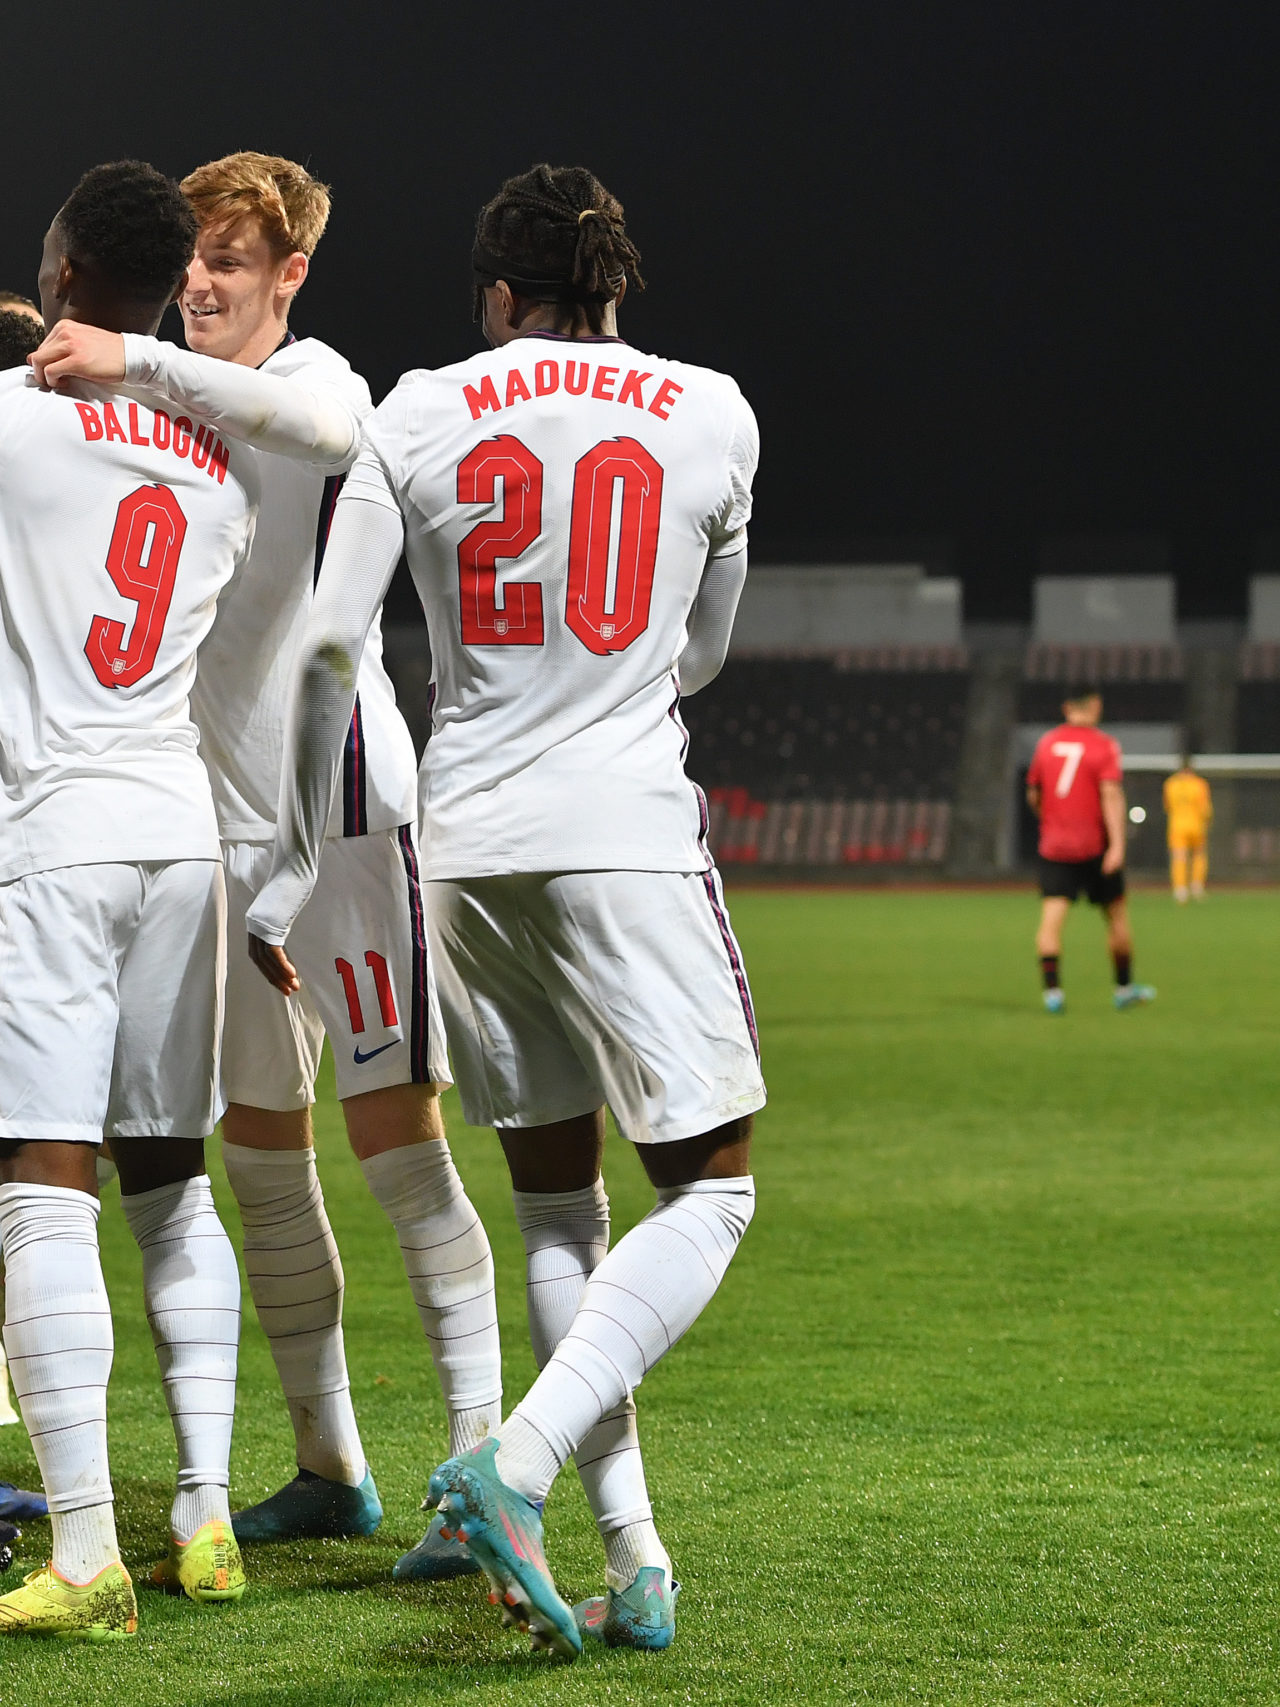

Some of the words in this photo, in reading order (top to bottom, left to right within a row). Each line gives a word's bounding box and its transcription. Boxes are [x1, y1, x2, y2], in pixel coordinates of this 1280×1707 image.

[463, 359, 684, 421] MADUEKE
[75, 402, 230, 485] BALOGUN
[84, 483, 188, 689] 9
[457, 433, 664, 656] 20
[1051, 742, 1084, 799] 7
[335, 950, 398, 1034] 11
